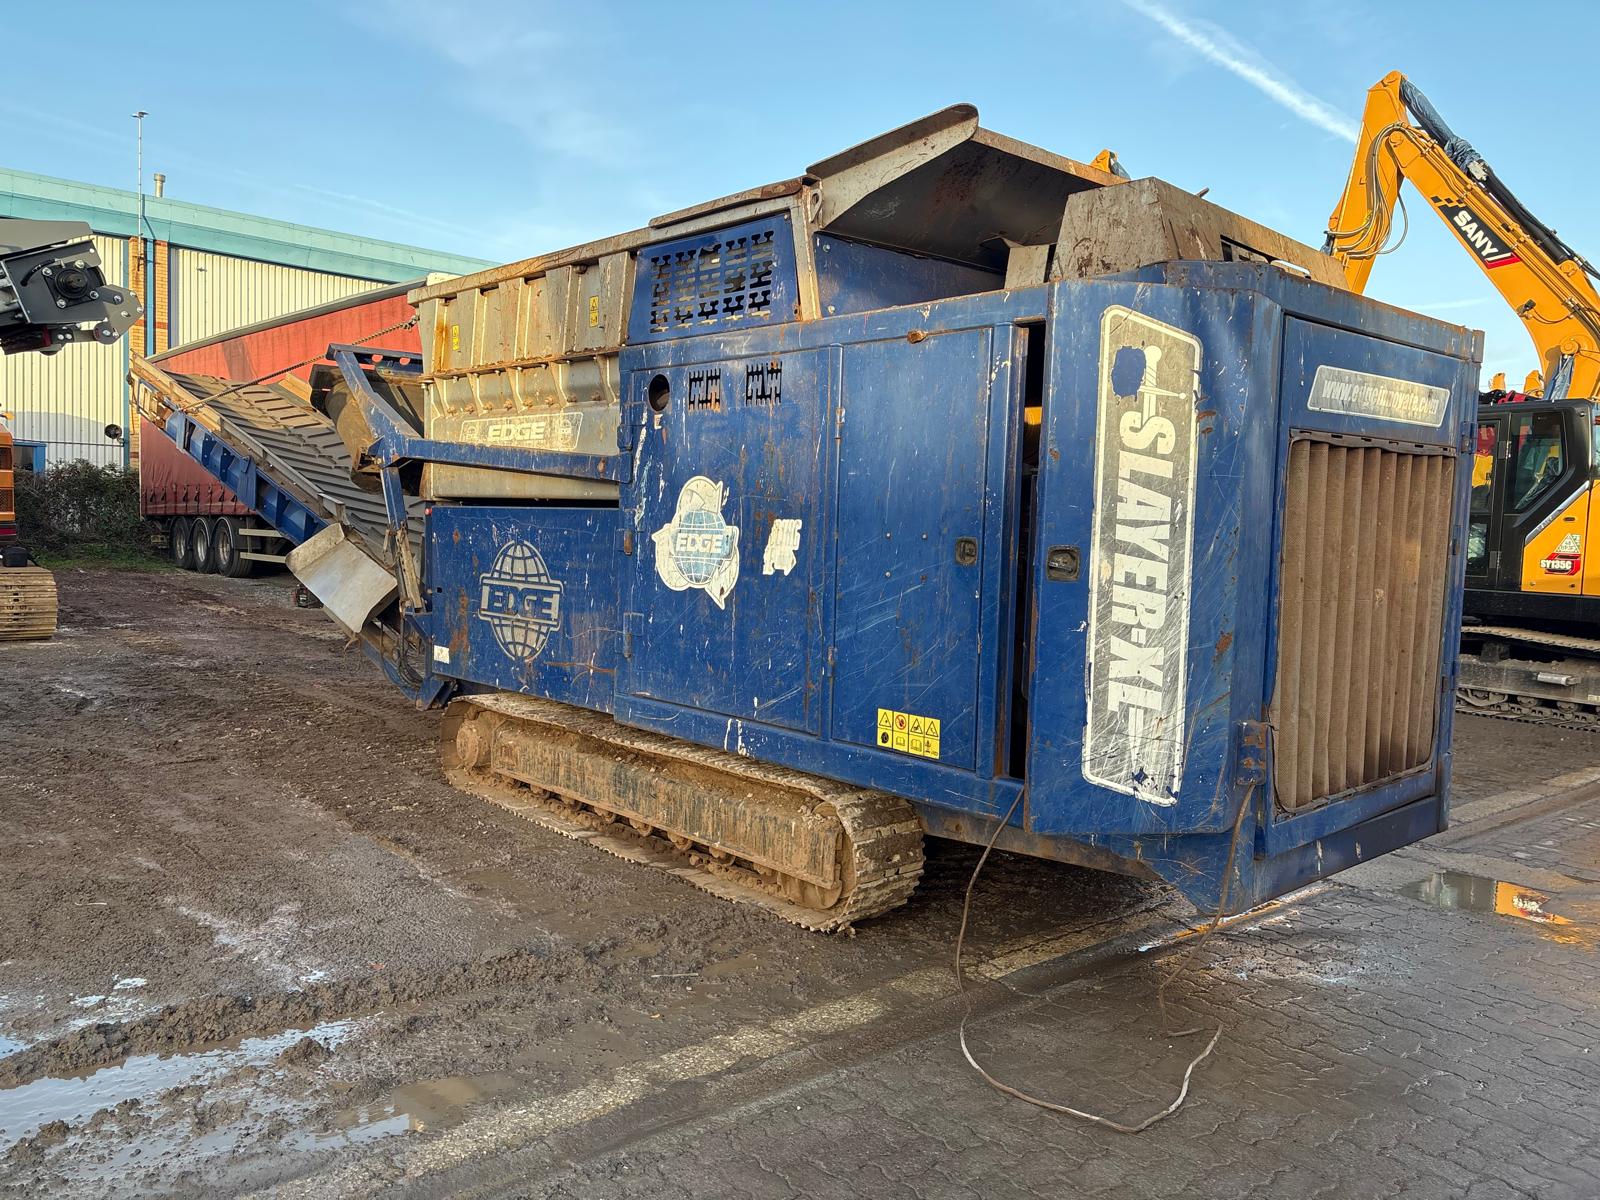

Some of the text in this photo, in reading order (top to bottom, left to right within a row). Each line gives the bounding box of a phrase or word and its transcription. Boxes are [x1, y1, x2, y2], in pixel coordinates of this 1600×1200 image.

[1453, 210, 1499, 256] SANY
[1321, 379, 1439, 415] www.edgeinnovate.com
[487, 421, 546, 442] EDGE
[676, 532, 724, 554] EDGE
[1107, 410, 1176, 714] SLAYER-XL
[487, 584, 555, 620] EDGE
